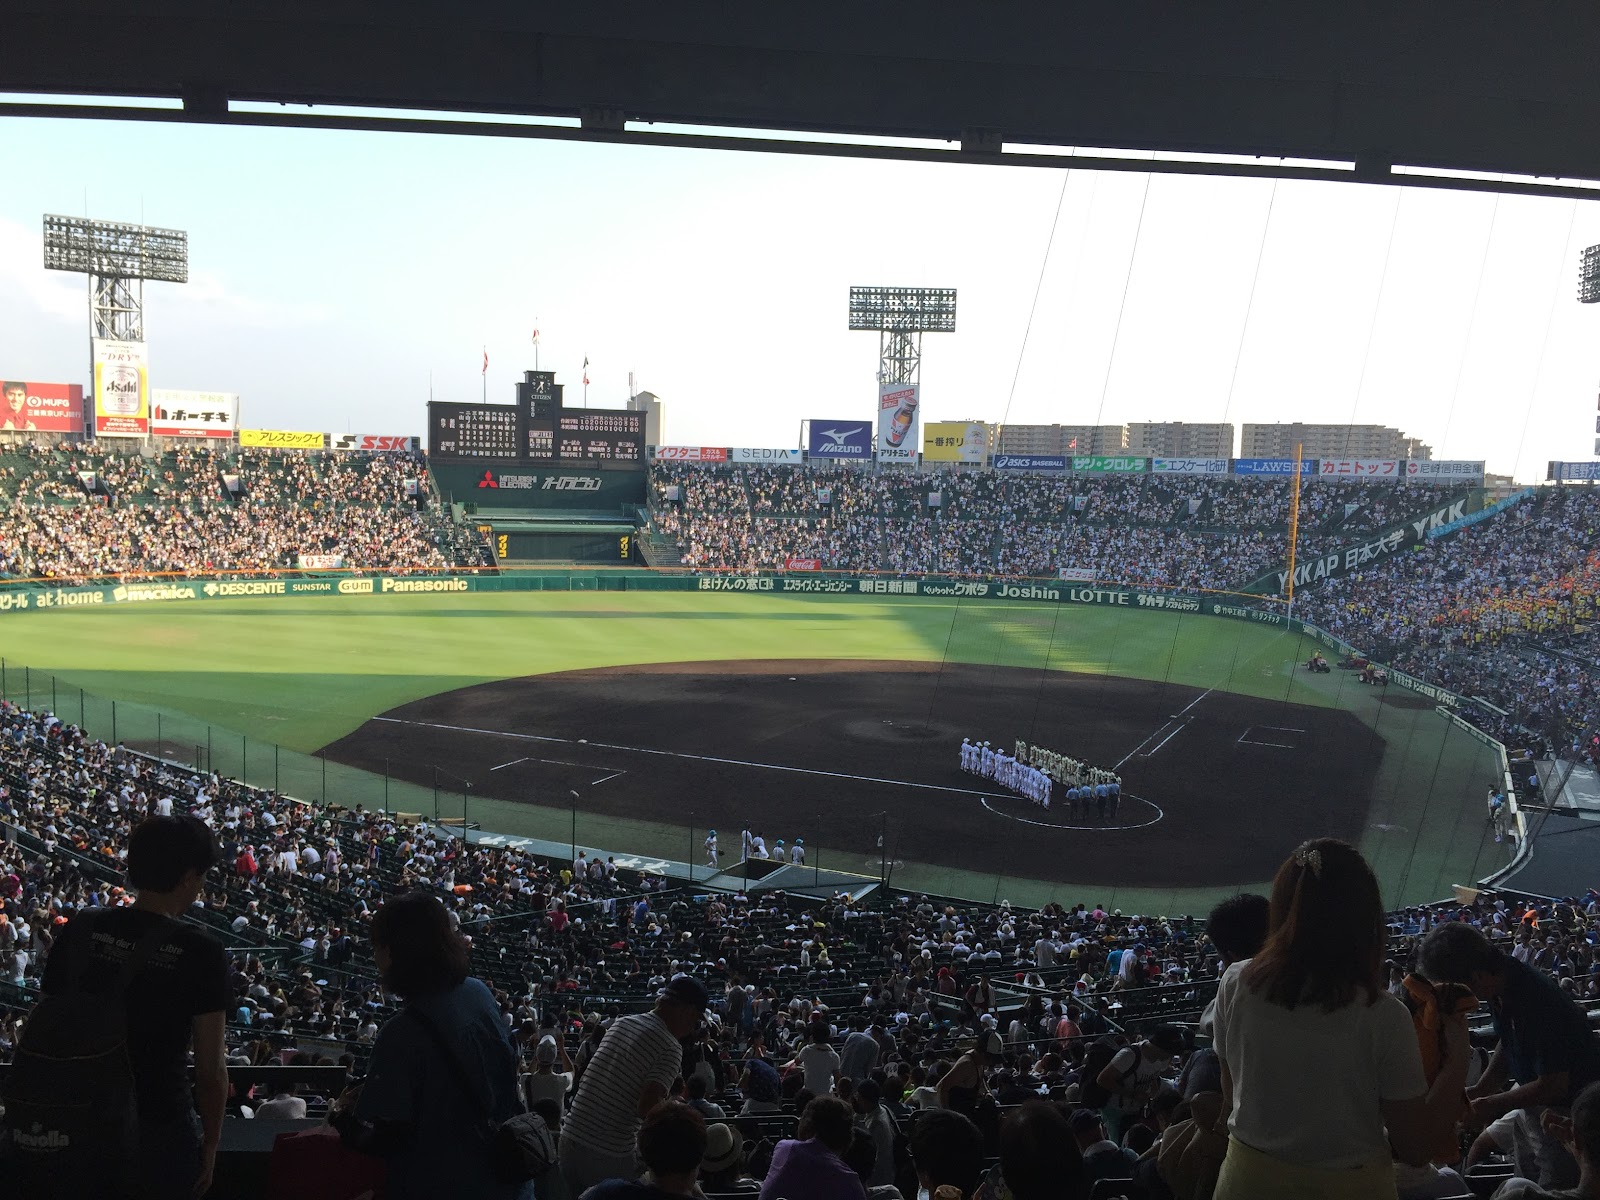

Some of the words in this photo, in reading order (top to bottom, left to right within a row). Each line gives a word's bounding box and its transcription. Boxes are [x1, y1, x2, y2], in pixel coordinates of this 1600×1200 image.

[106, 380, 137, 393] Asahi
[42, 399, 70, 407] MUFG
[171, 410, 230, 422] ホーチキ
[259, 432, 322, 444] アレスシックイ
[360, 436, 409, 450] SSK
[925, 437, 964, 447] 一番搾り
[657, 447, 700, 458] イワタニ
[742, 448, 789, 458] SEDIA
[1008, 458, 1030, 467] asics
[1074, 458, 1144, 471] サン・クロレラ
[1167, 461, 1226, 472] エスケー化研
[1252, 461, 1310, 472] LAWSON
[1322, 461, 1397, 474] カニトップ
[1420, 463, 1482, 474] 尼崎信用金庫
[1570, 463, 1600, 478] 藍野大
[542, 476, 603, 490] オーロラビジョン
[1412, 500, 1468, 540] YKK
[498, 534, 508, 558] グリコ
[620, 536, 629, 559] グリコ
[1345, 529, 1405, 570] 日本大学
[1278, 563, 1311, 595] YKK
[1314, 555, 1338, 582] AP
[219, 582, 285, 595] DESCENTE
[292, 583, 331, 591] SUNSTAR
[381, 578, 468, 592] Panasonic
[859, 580, 918, 594] 朝日新聞
[923, 585, 954, 595] Kubota
[954, 583, 988, 596] クボタ
[36, 594, 54, 608] at
[54, 589, 103, 606] home
[997, 585, 1060, 600] Joshin
[1070, 588, 1129, 605] LOTTE
[1137, 594, 1165, 608] タカラ
[1258, 613, 1281, 624] リンテック
